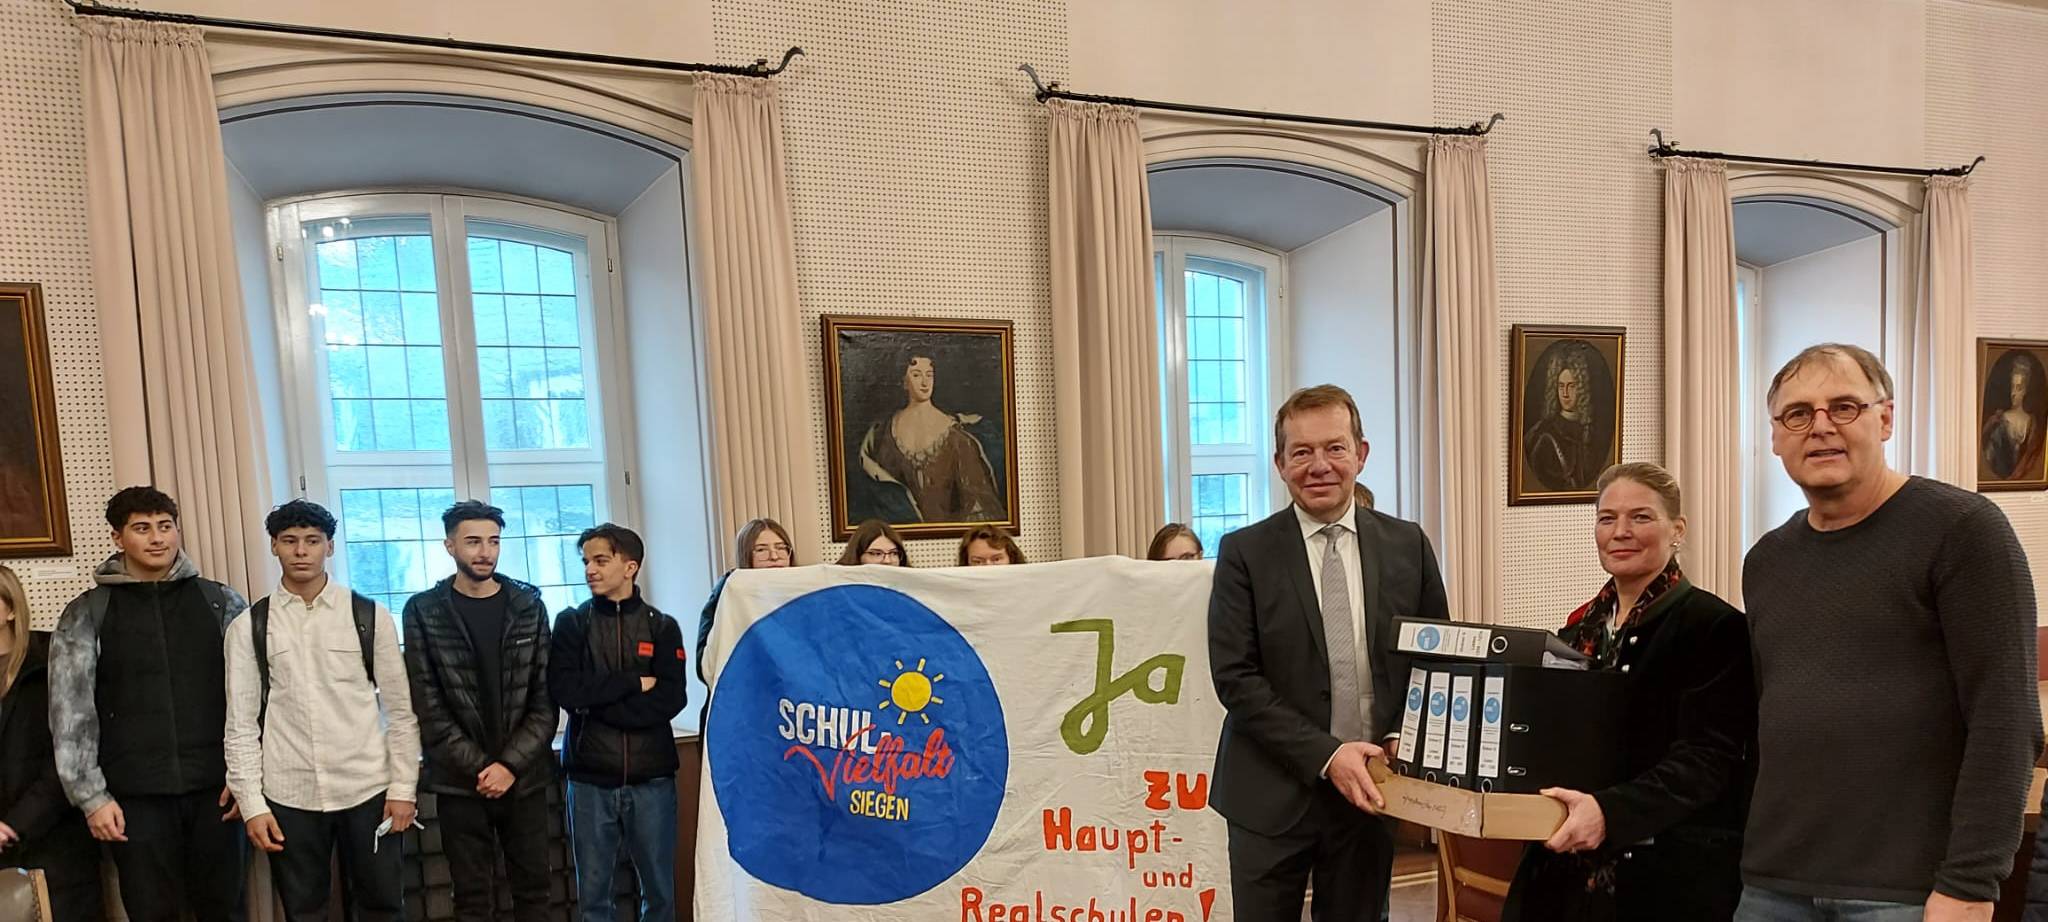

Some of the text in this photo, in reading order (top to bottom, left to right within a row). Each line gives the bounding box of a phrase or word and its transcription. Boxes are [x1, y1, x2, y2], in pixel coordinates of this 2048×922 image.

[1050, 618, 1186, 756] Ja
[783, 723, 955, 801] Vielfalt
[850, 789, 910, 821] SIEGEN
[1043, 807, 1183, 869] Haupt-
[1143, 863, 1193, 888] und
